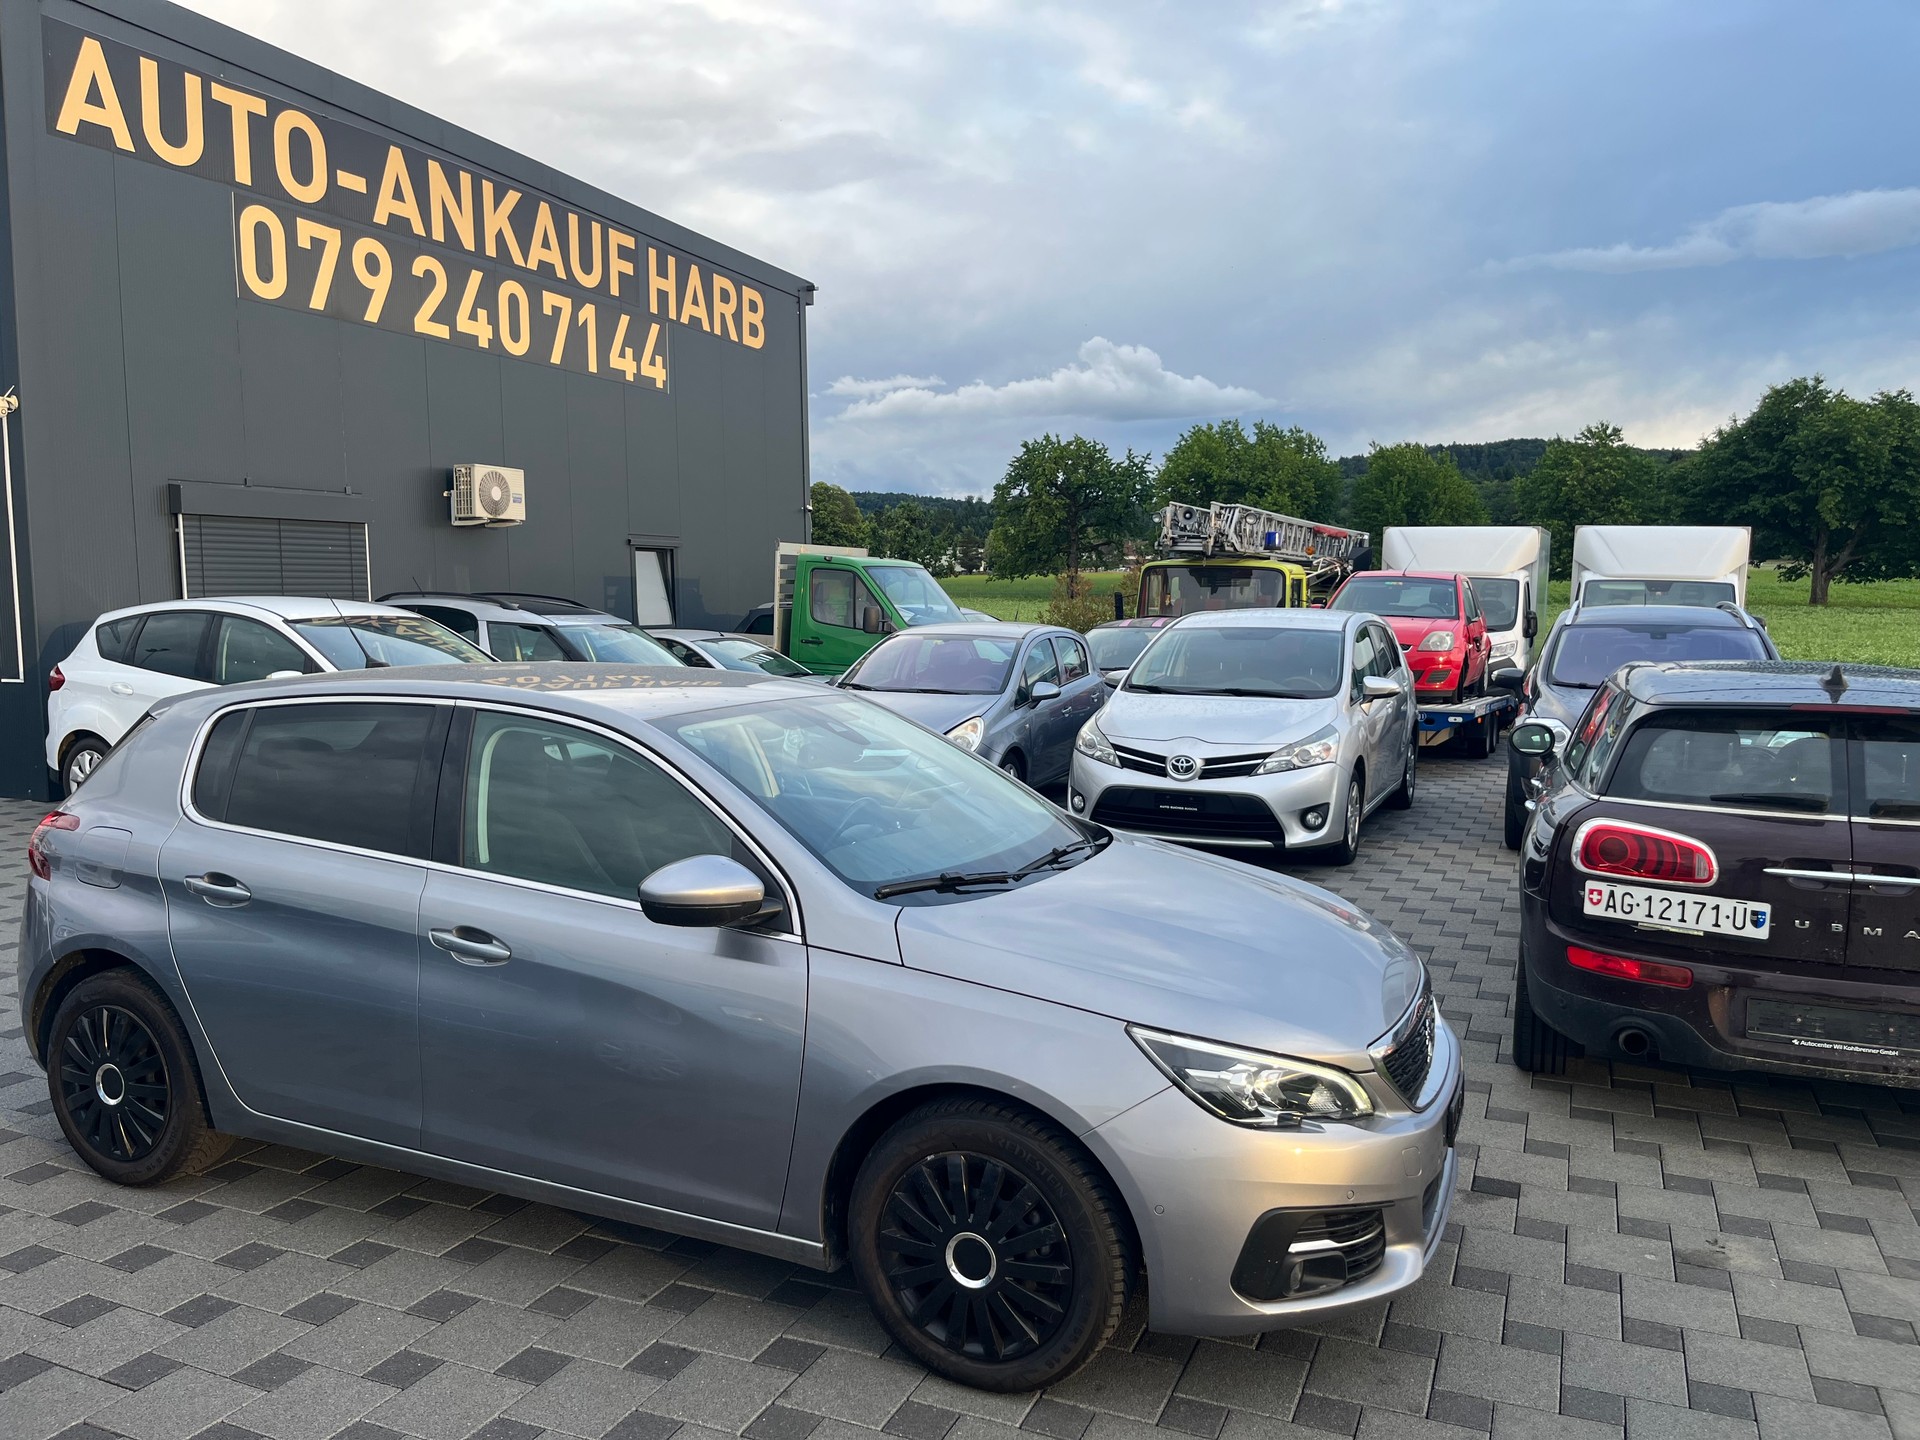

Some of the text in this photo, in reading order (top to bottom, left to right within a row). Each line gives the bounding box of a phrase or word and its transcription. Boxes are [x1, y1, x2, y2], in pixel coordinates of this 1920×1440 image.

[57, 37, 764, 349] AUTO-ANKAUF HARB
[240, 205, 392, 323] 079
[412, 255, 530, 356] 240
[1800, 1040, 1833, 1049] Autocenter
[1880, 1048, 1899, 1056] GmbH
